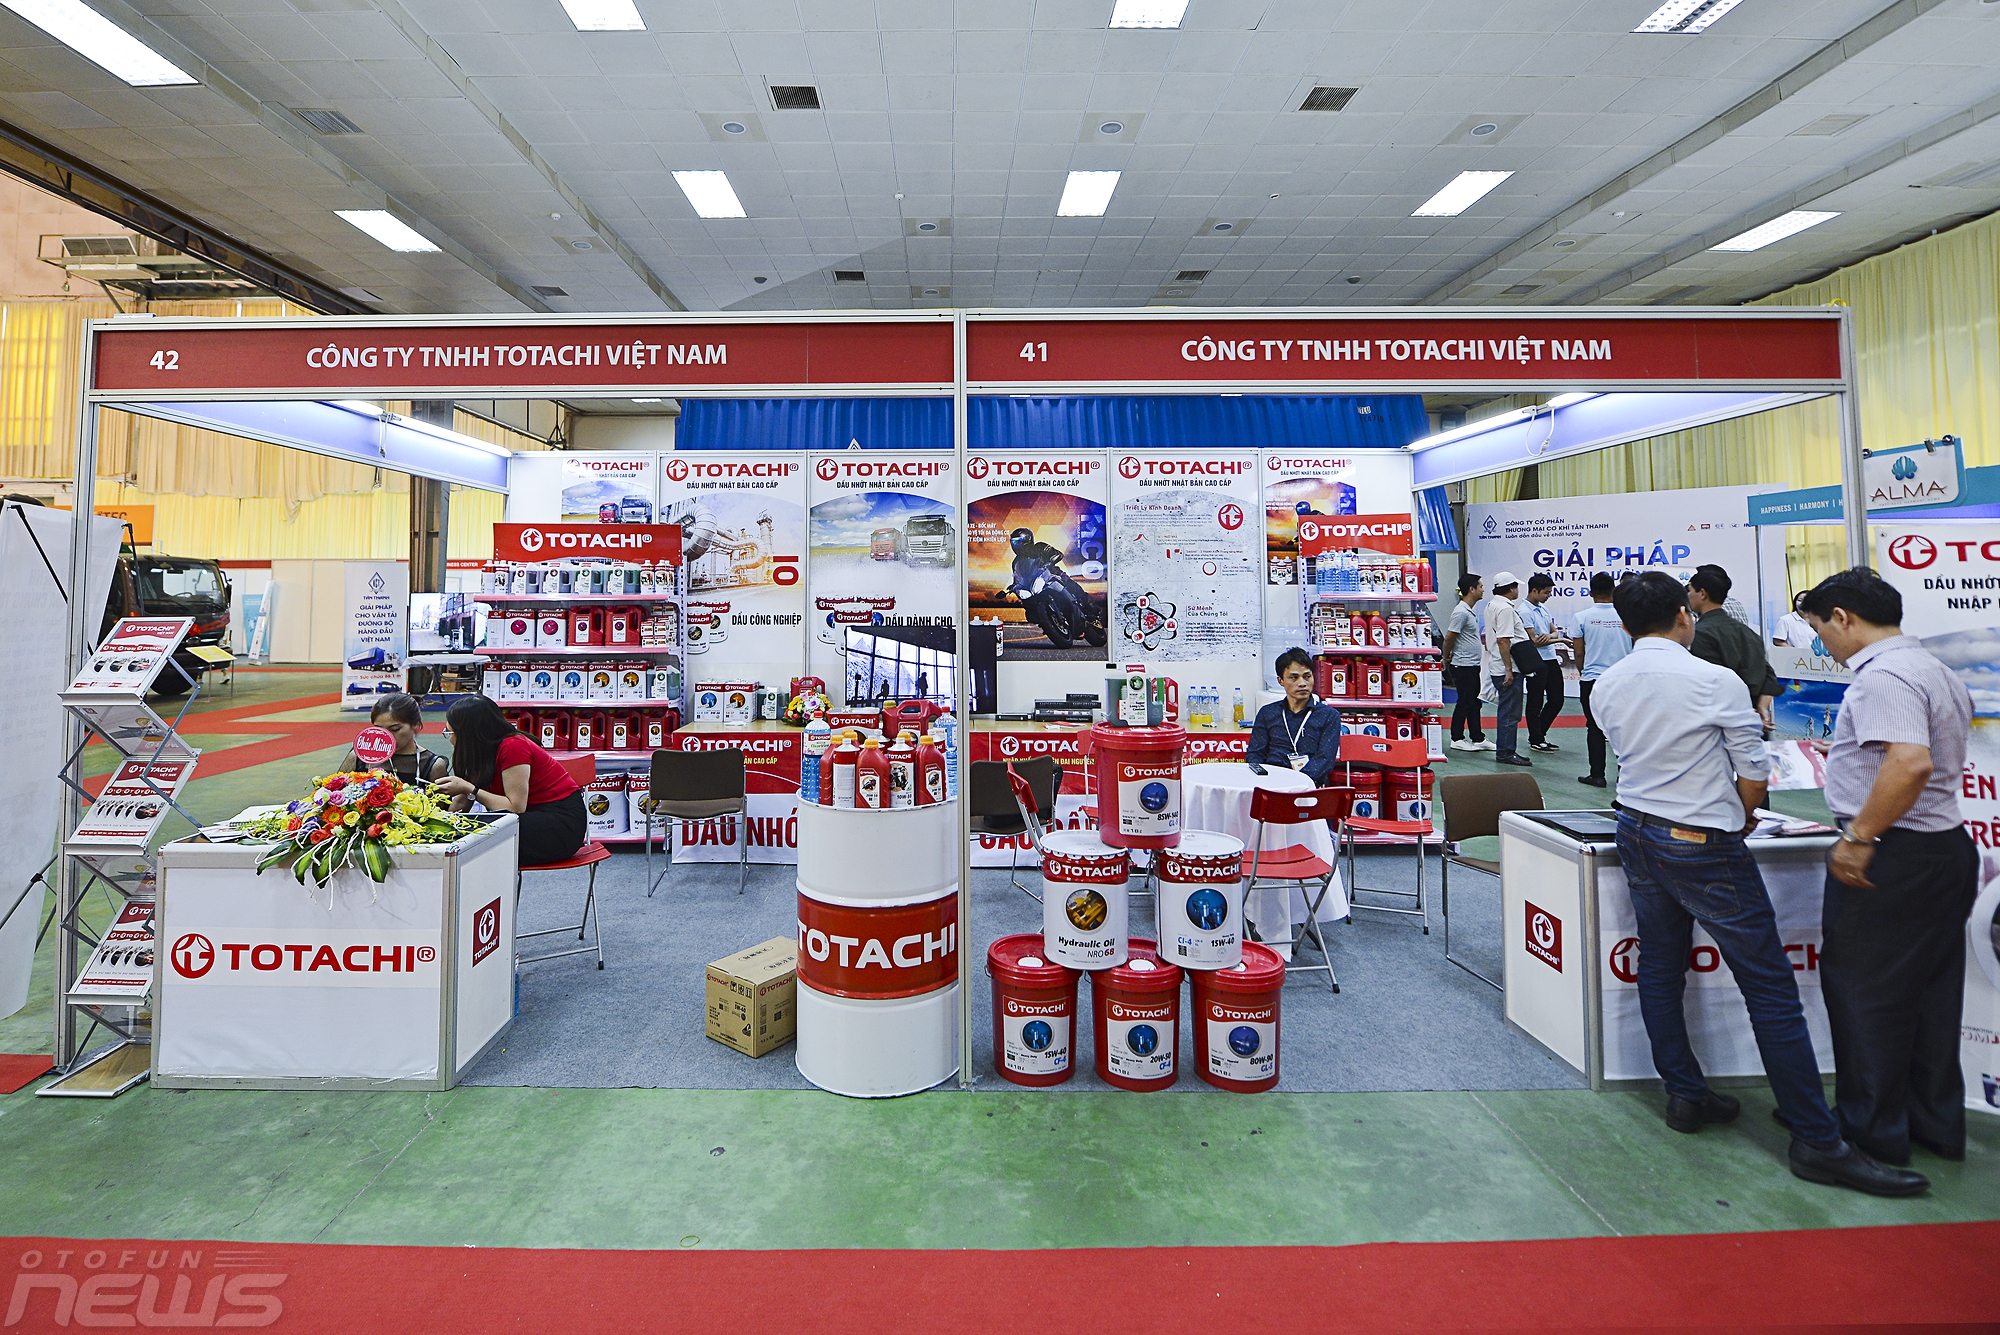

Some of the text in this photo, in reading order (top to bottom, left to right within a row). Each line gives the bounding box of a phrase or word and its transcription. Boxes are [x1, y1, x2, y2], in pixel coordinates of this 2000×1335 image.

[306, 339, 727, 370] CÔNG TY TNHH TOTACHI VIỆT NAM
[1020, 342, 1048, 362] 41
[1181, 335, 1612, 365] CÔNG TY TNHH TOTACHI VIỆT NAM
[150, 350, 179, 370] 42
[901, 481, 914, 489] CAO
[1869, 481, 1947, 502] ALMA
[1761, 504, 1792, 514] HAPPINESS
[1800, 500, 1830, 510] HARMONY
[1533, 538, 1691, 568] GIẢI PHÁP
[1924, 573, 1955, 589] DẦU
[1948, 595, 1991, 612] NHẬP
[732, 611, 802, 627] DẦU CÔNG NGHIỆP
[934, 615, 953, 626] CHO
[1136, 767, 1178, 776] TOTACHI
[1061, 864, 1122, 877] TOTACHI
[1181, 862, 1240, 877] TOTACHI
[798, 918, 956, 969] TOTACHI
[1058, 936, 1115, 948] Hydraulic Oil
[1211, 937, 1235, 947] 15W-40
[1087, 949, 1104, 958] NRO
[1527, 940, 1560, 965] TOTACHI
[1019, 1003, 1066, 1014] TOTACHI
[1124, 1008, 1171, 1019] TOTACHI
[1224, 1009, 1272, 1019] TOTACHI
[1045, 1047, 1067, 1058] 15W-40
[1250, 1054, 1274, 1065] 80W-90
